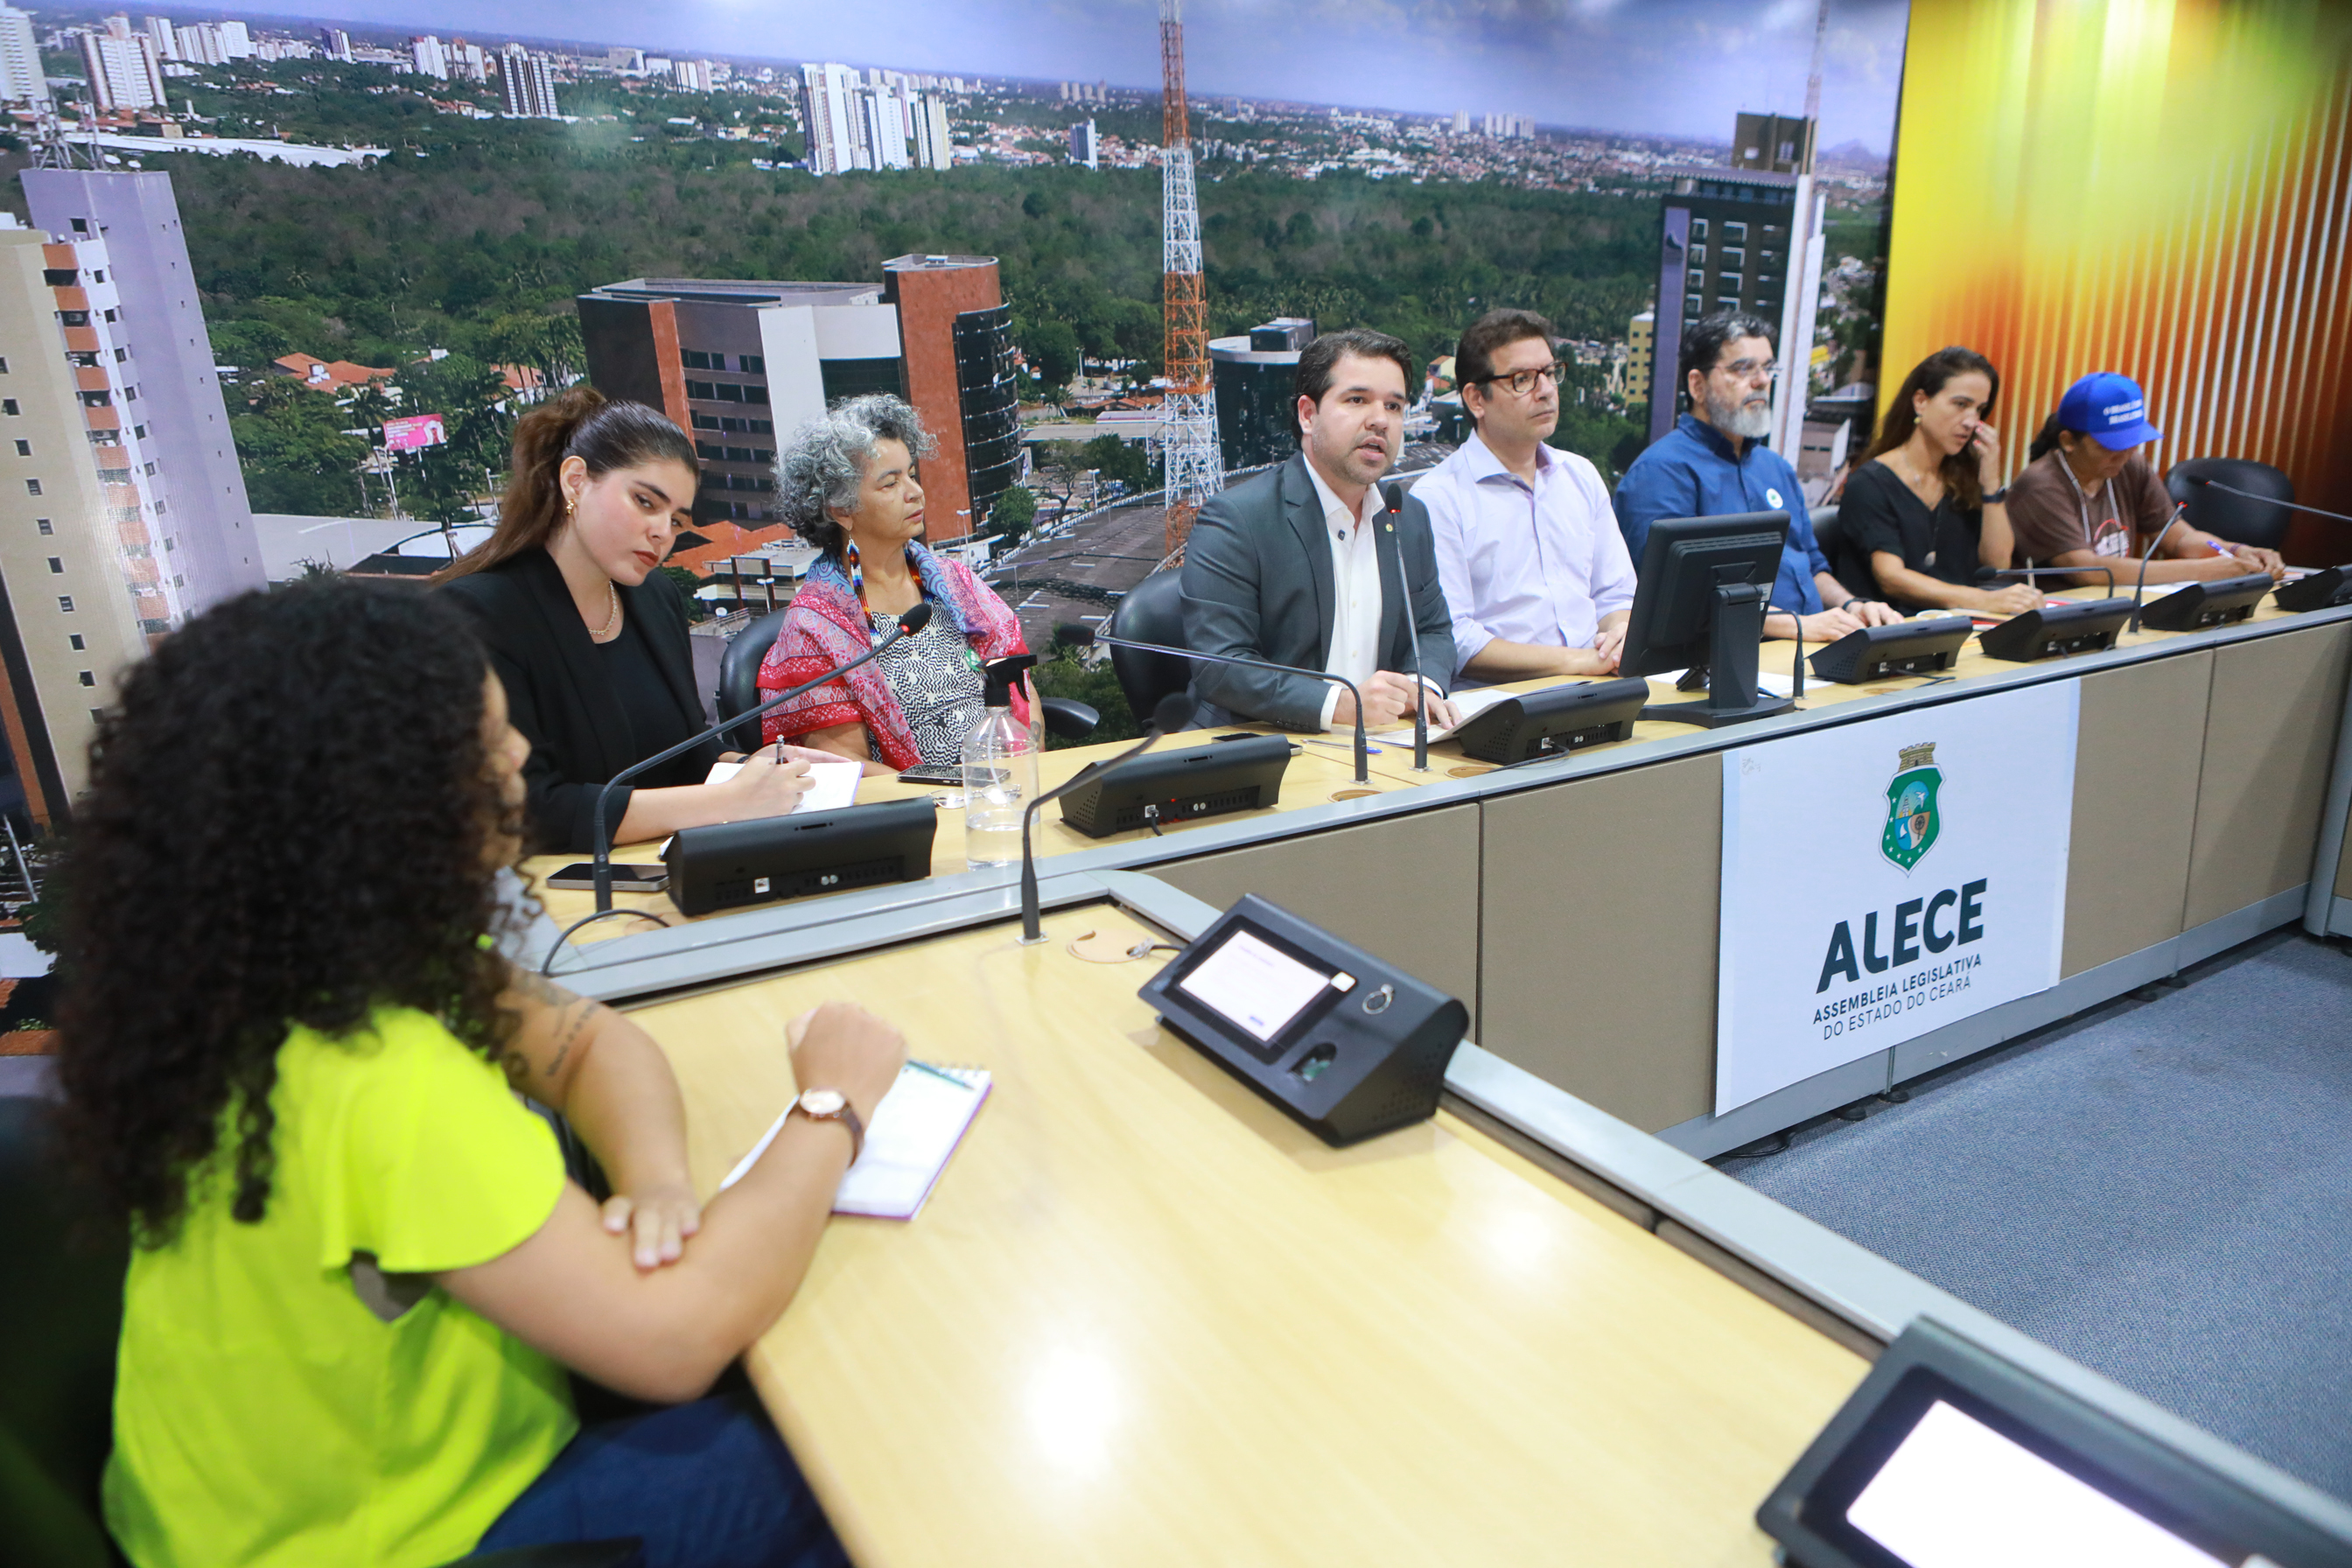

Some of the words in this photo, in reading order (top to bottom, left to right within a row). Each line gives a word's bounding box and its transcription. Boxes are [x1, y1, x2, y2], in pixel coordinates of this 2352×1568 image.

[1816, 878, 1987, 995] ALECE
[1813, 982, 1898, 1025] ASSEMBLEIA
[1902, 953, 1982, 992] LEGISLATIVA
[1824, 1021, 1844, 1040] DO
[1849, 999, 1902, 1031] ESTADO
[1907, 991, 1925, 1010] DO
[1929, 971, 1970, 1001] CEARÁ
